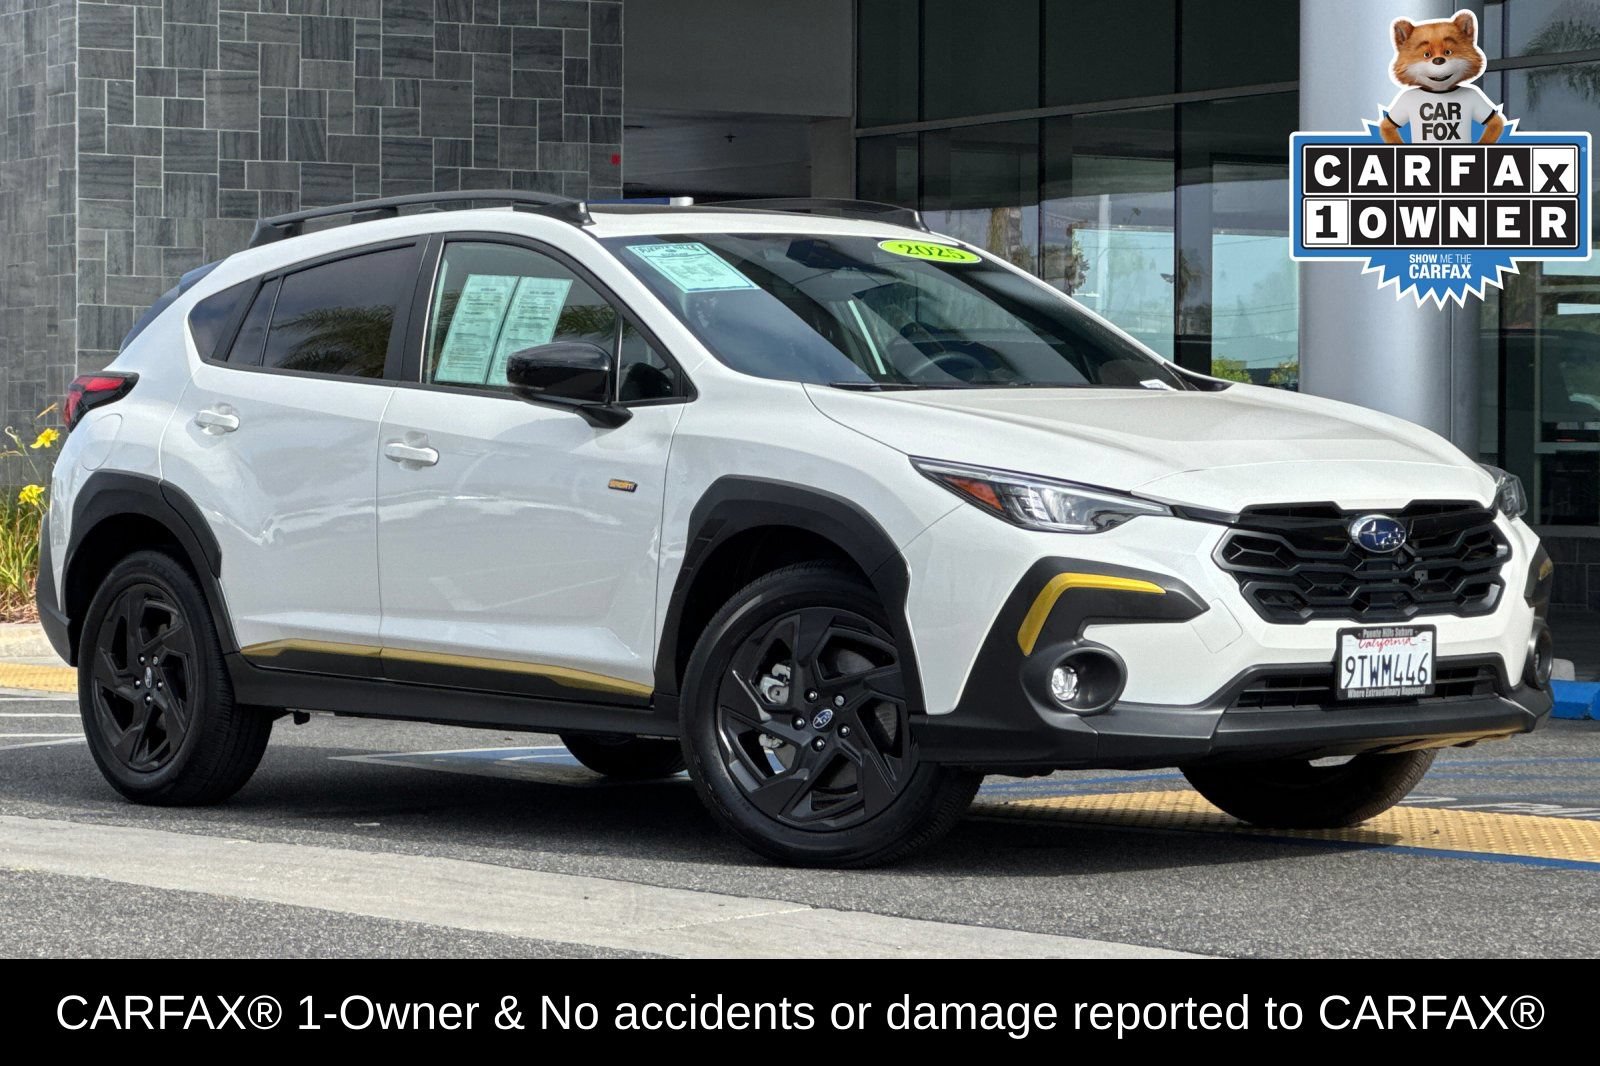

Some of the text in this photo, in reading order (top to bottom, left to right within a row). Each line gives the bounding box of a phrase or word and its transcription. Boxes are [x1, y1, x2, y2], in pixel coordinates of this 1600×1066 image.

[898, 244, 966, 260] 2025
[1359, 637, 1417, 653] California
[1345, 652, 1429, 688] 9TWM446
